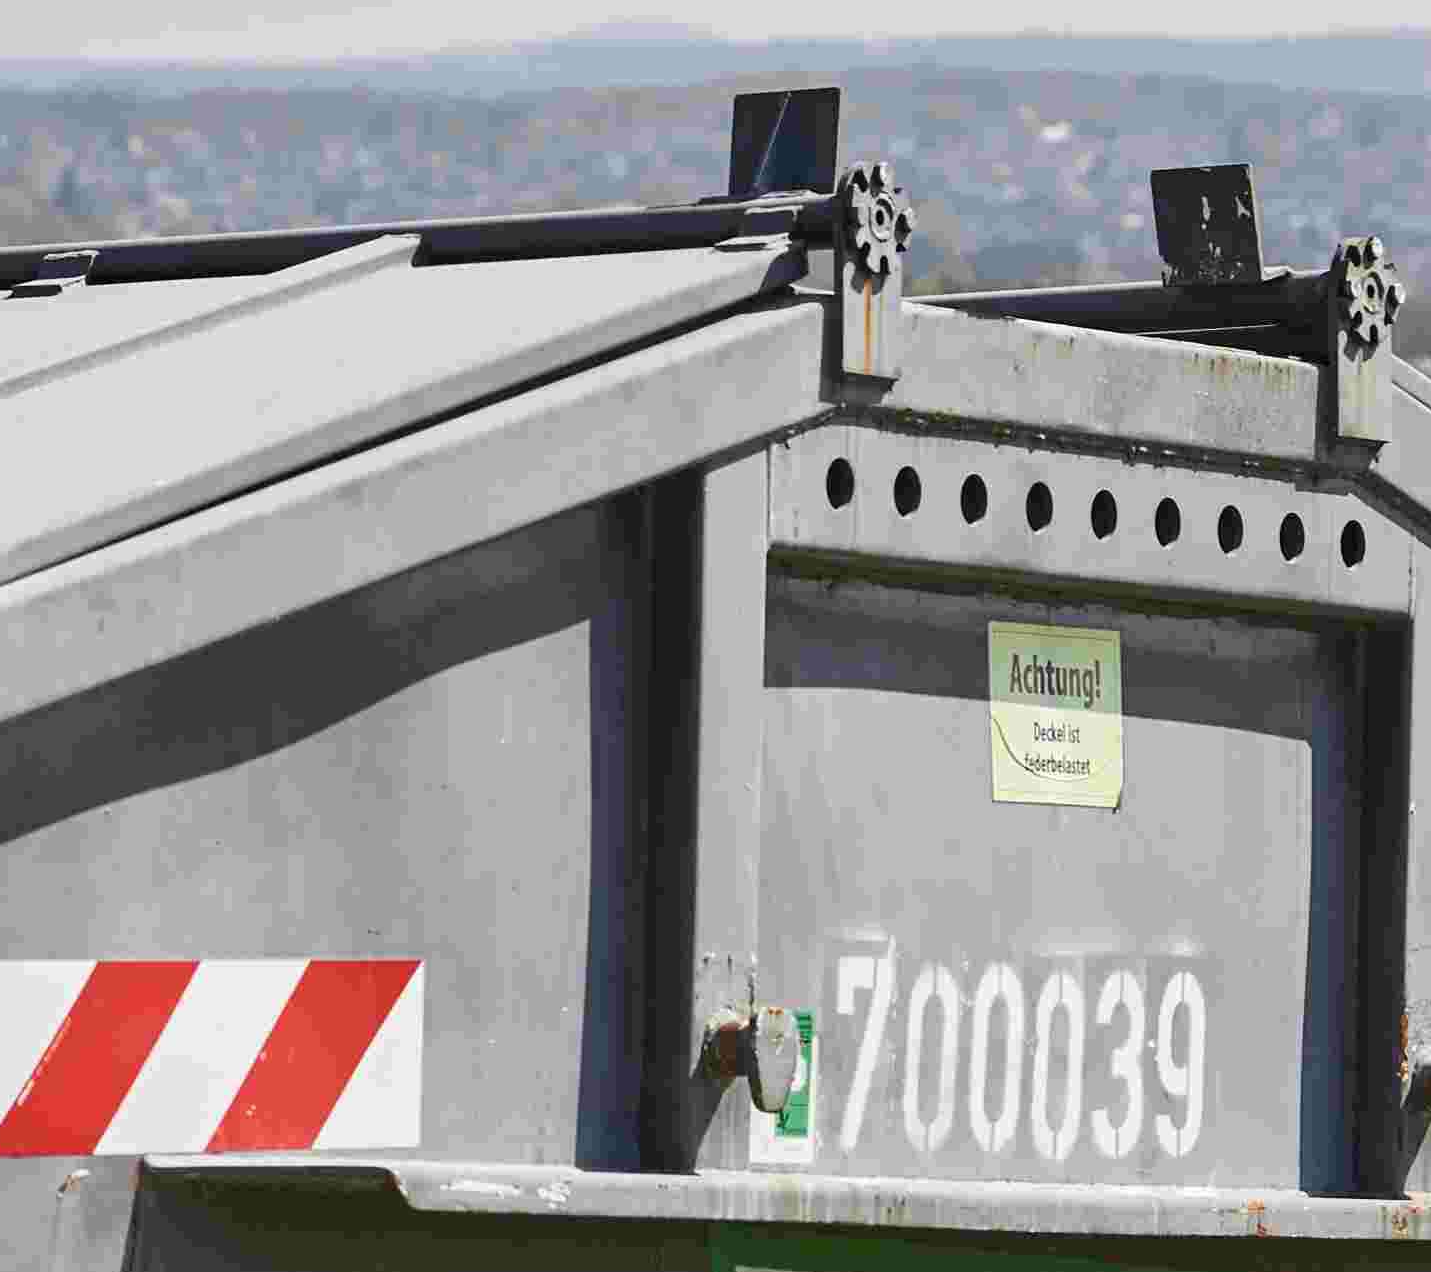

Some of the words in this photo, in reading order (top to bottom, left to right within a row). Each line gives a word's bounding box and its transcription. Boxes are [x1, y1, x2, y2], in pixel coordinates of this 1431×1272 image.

[1009, 653, 1102, 708] Achtung!
[1034, 721, 1065, 743] Deckel
[1068, 722, 1081, 744] ist
[837, 933, 1207, 1161] 700039
